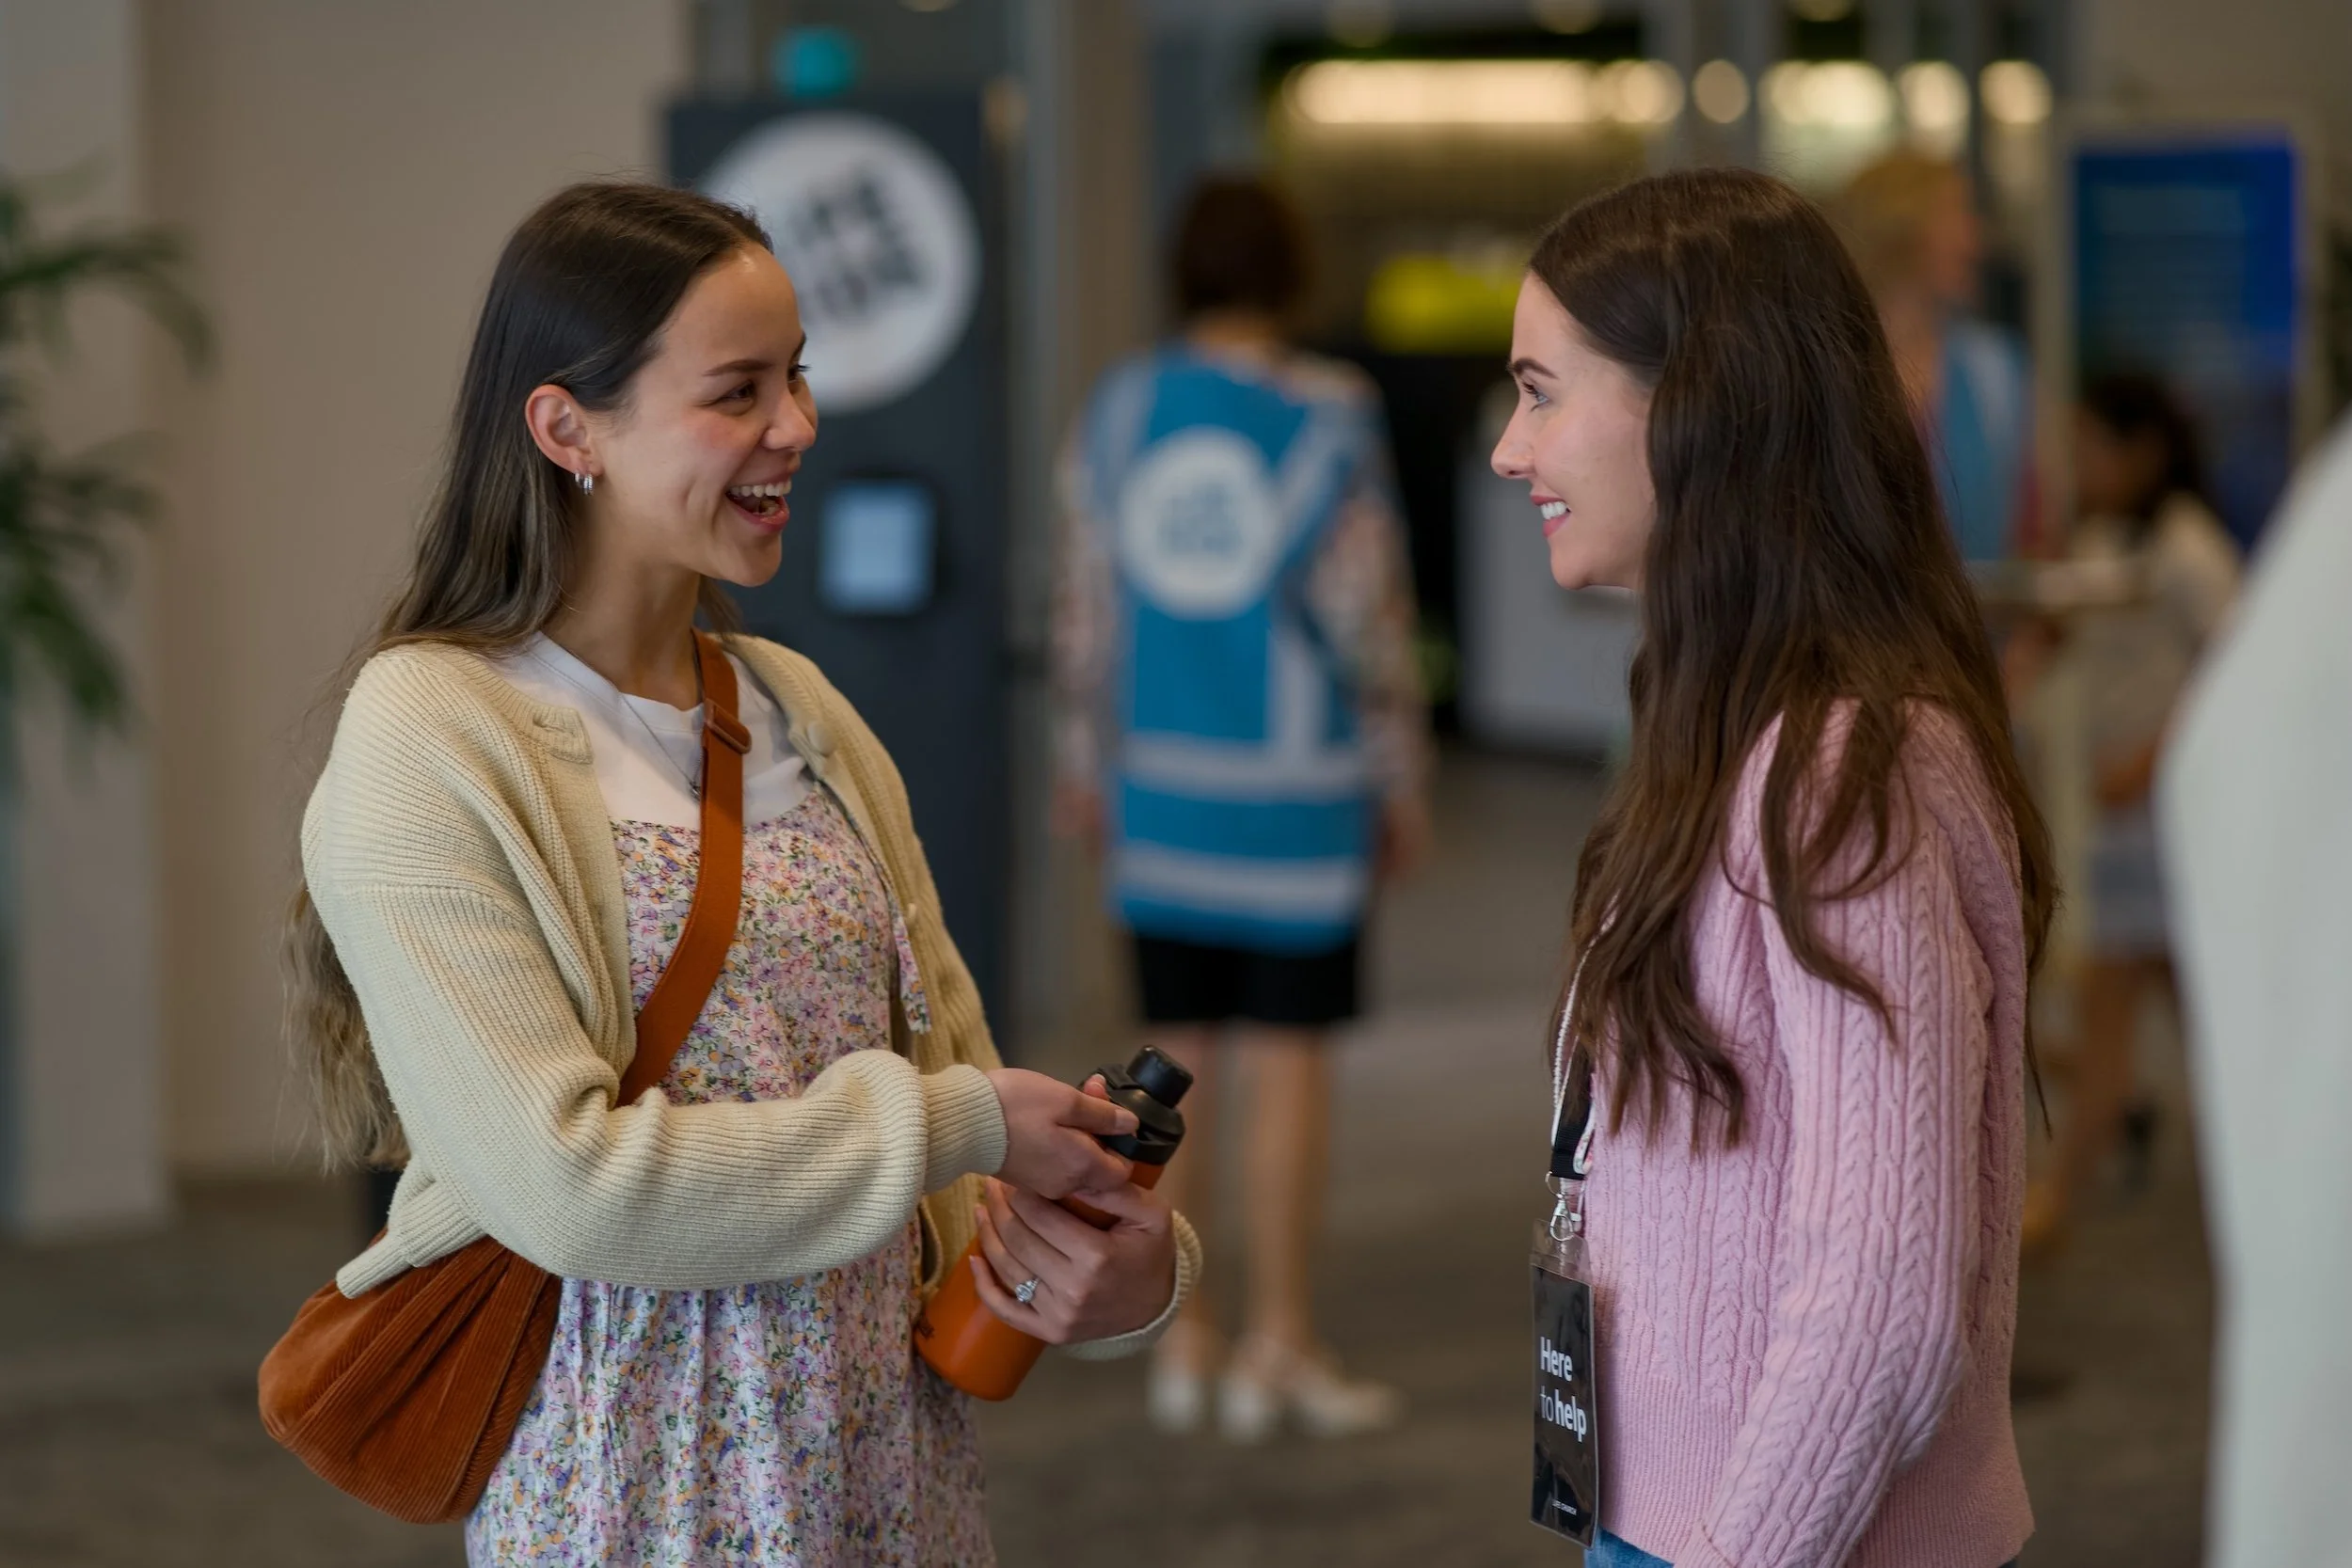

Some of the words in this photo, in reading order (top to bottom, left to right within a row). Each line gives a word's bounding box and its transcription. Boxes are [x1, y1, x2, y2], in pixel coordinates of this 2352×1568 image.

[1540, 1336, 1573, 1382] Here
[1540, 1385, 1554, 1422] to
[1554, 1388, 1587, 1443] help
